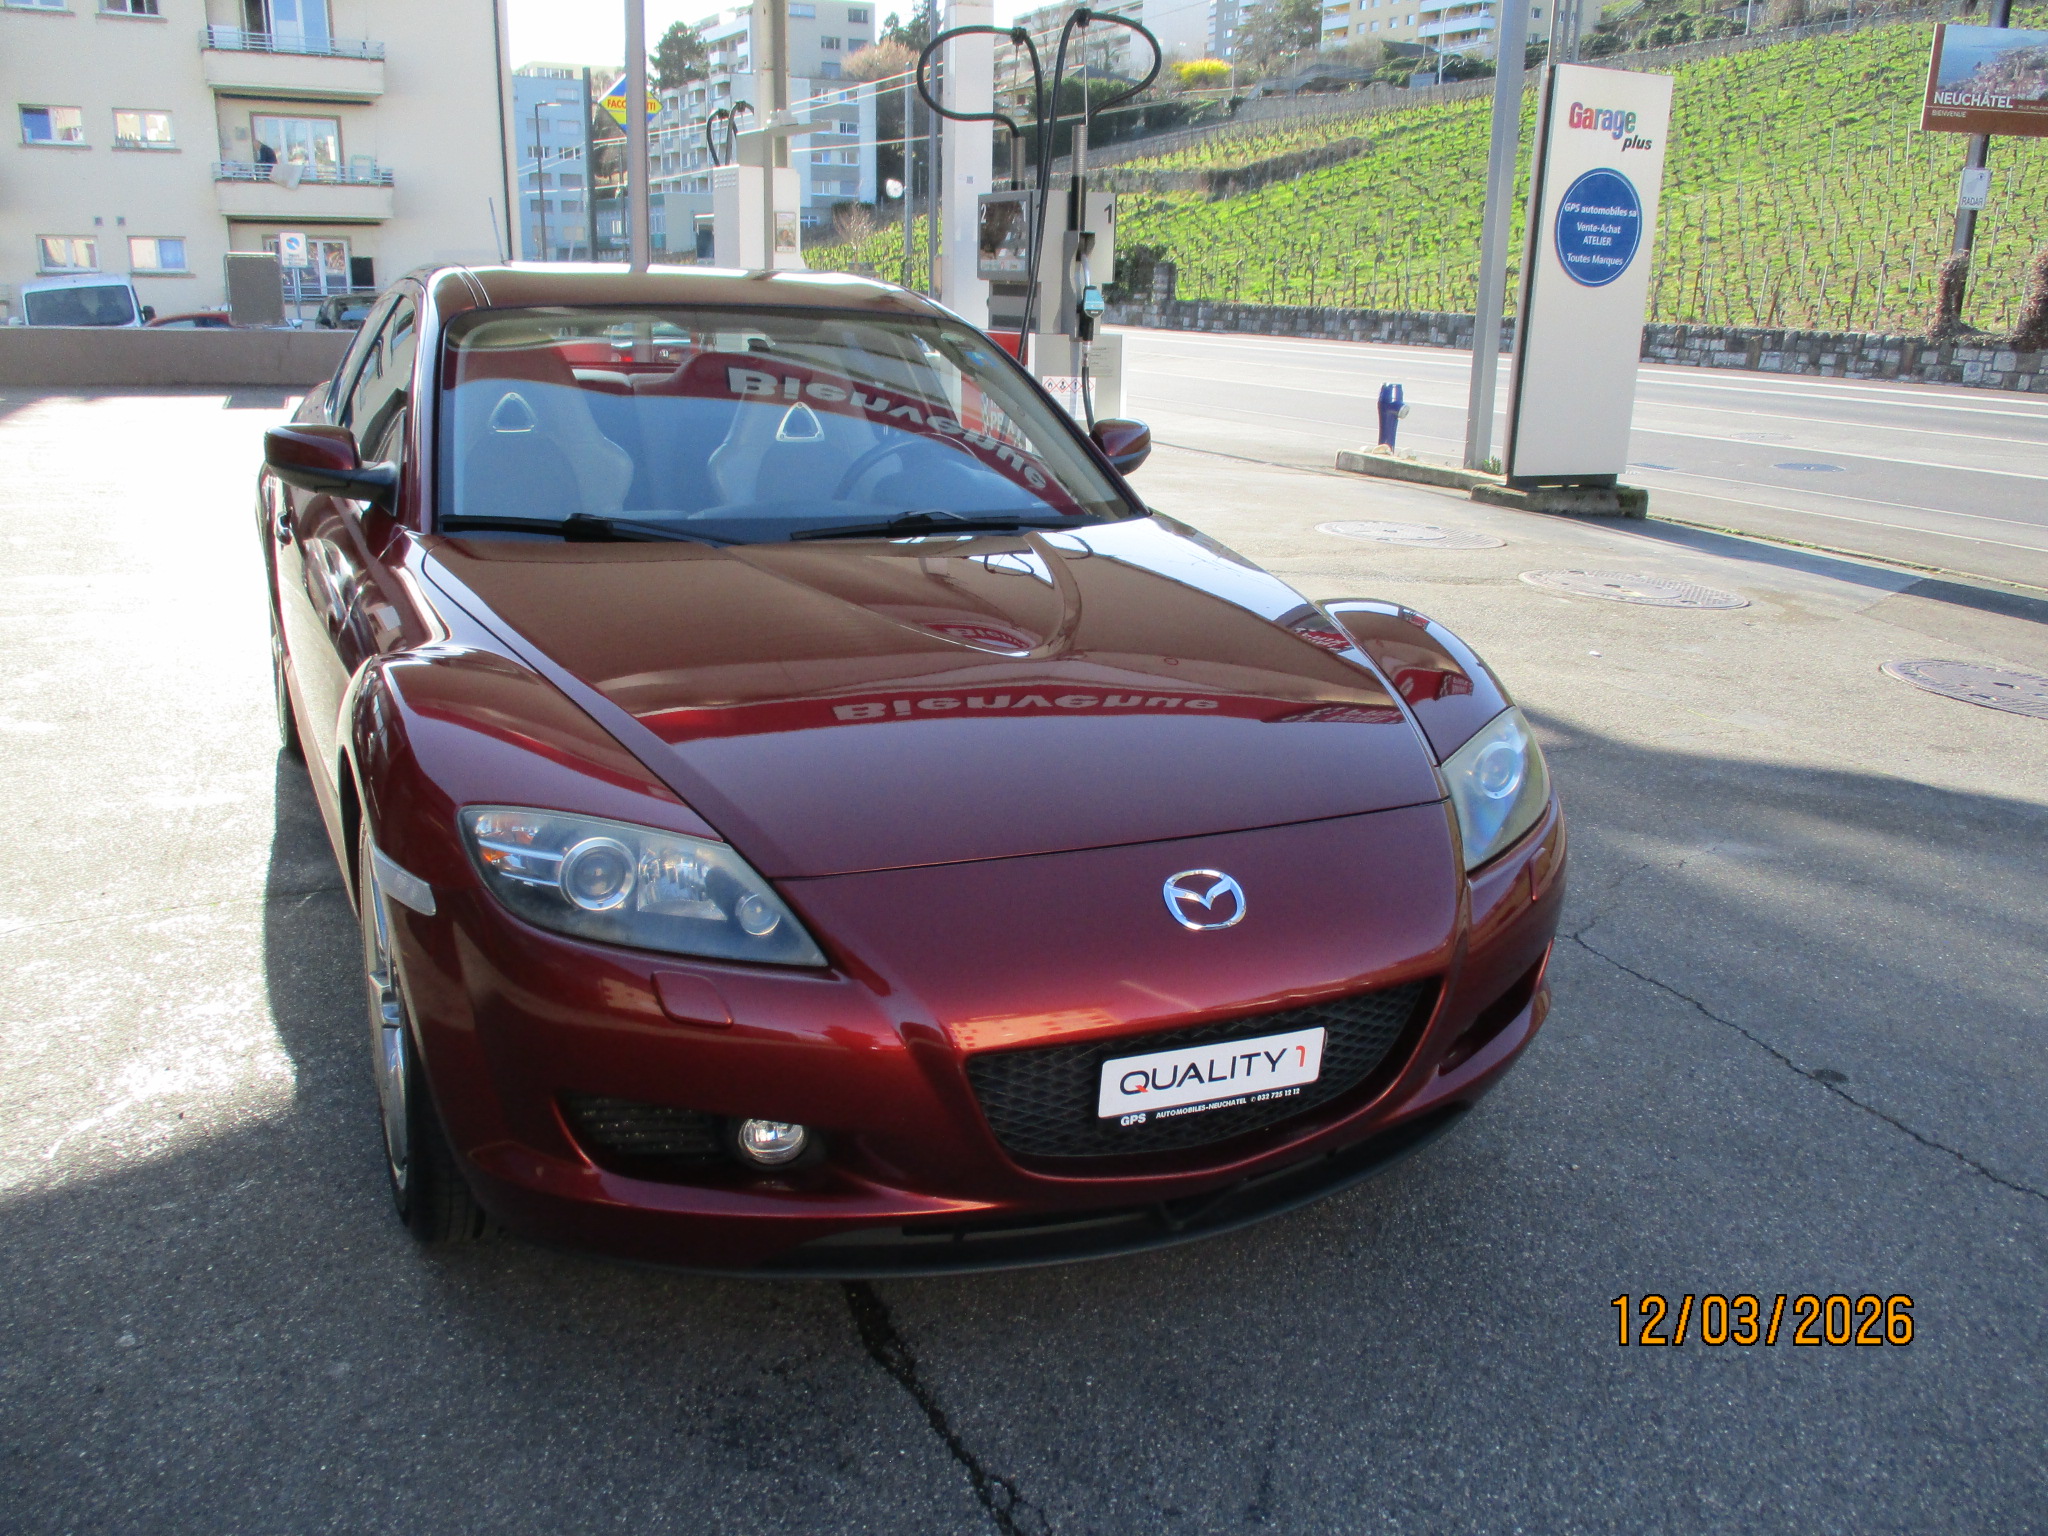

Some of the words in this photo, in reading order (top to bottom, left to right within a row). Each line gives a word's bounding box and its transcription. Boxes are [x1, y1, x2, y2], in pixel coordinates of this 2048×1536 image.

[1934, 91, 2014, 109] NEUCHÂTEL
[1569, 101, 1637, 140] Garage
[1620, 134, 1653, 152] plus
[1564, 202, 1581, 213] GPS
[1581, 205, 1628, 217] automobiles
[1628, 209, 1637, 218] sa
[1961, 196, 1984, 207] RADAR
[1103, 203, 1113, 225] 1
[1576, 221, 1622, 234] Vente-Achat
[1582, 235, 1613, 246] ATELIER
[1567, 252, 1591, 263] Toutes
[1591, 254, 1624, 267] Marques
[1119, 1047, 1288, 1096] QUALITY
[1295, 1045, 1306, 1068] 1
[1120, 1112, 1147, 1127] GPS
[1155, 1096, 1248, 1119] AUTOMOBILES-NEUCHATEL
[1256, 1093, 1270, 1102] 032
